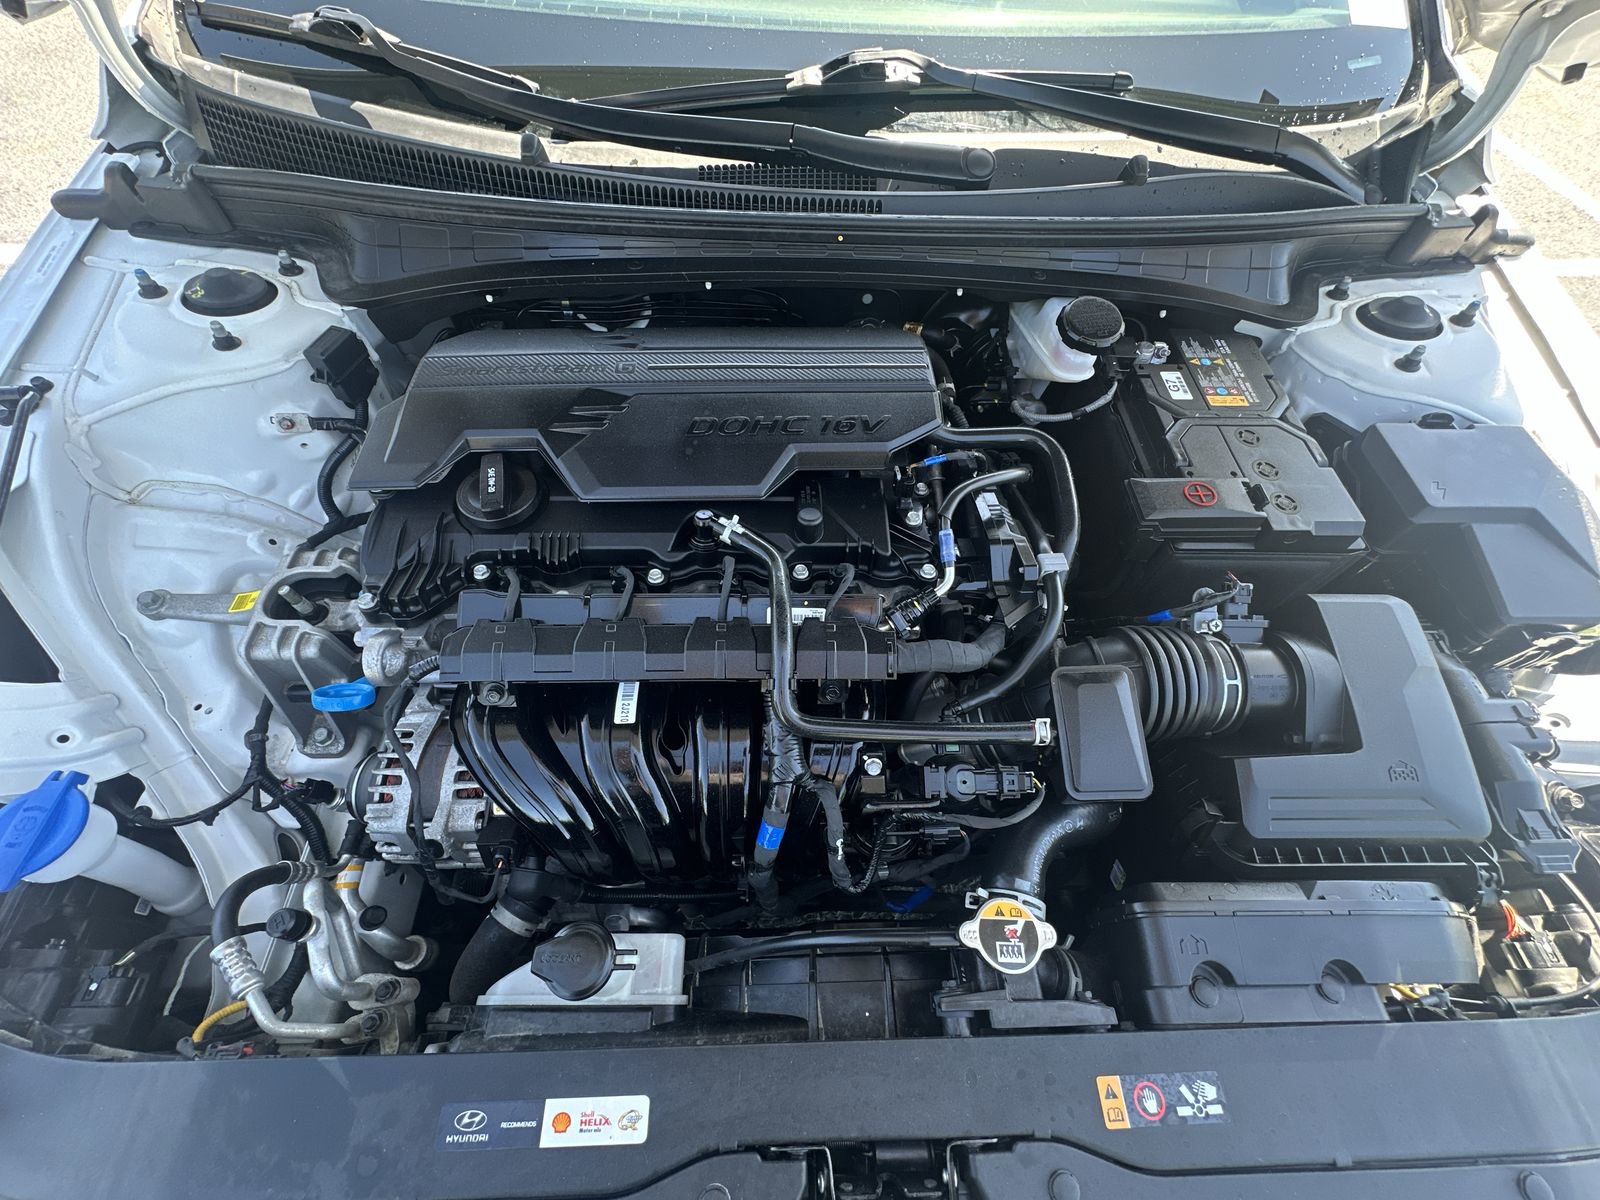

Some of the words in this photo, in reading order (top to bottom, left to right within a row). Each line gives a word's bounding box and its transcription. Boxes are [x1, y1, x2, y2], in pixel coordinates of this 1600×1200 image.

[1165, 378, 1181, 393] G7
[685, 415, 810, 436] DOHC
[820, 414, 892, 436] 16V
[620, 702, 631, 723] 2J210
[580, 1110, 595, 1118] Shell
[500, 1121, 537, 1129] RECOMMENDS
[579, 1117, 612, 1127] HELIX
[445, 1133, 489, 1144] HYUNDAI
